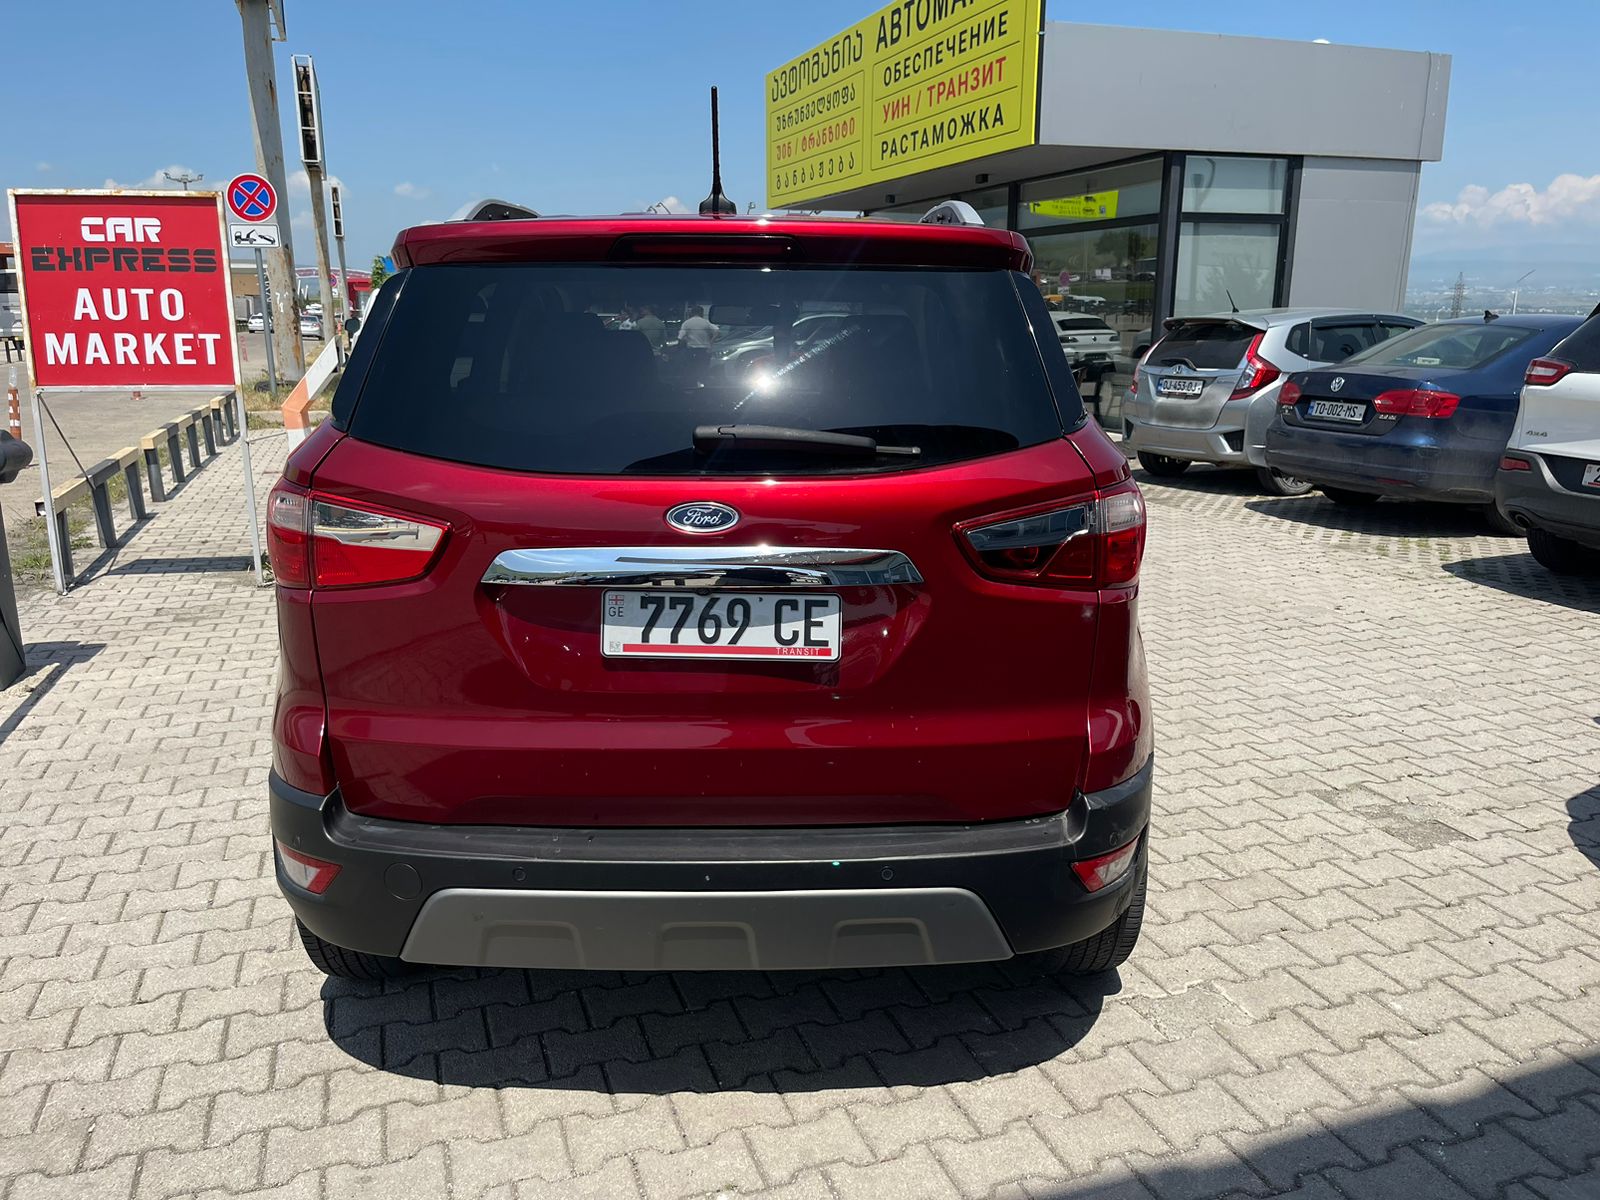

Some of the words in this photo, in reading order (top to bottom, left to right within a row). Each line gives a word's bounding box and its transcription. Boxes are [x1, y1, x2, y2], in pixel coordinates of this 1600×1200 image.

[884, 10, 1009, 88] ОБЕСПЕЧЕНИЕ
[883, 95, 911, 124] УИН
[927, 56, 1007, 108] ТРАНЗИТ
[881, 103, 1004, 161] РАСТАМОЖКА
[80, 216, 162, 243] CAR
[31, 247, 217, 273] EXPRESS
[73, 287, 185, 322] AUTO
[44, 332, 222, 366] MARKET
[683, 507, 722, 525] Ford
[608, 606, 624, 618] GE
[639, 595, 751, 645] 7769
[773, 598, 829, 648] CE
[776, 647, 820, 656] TRANSIT
